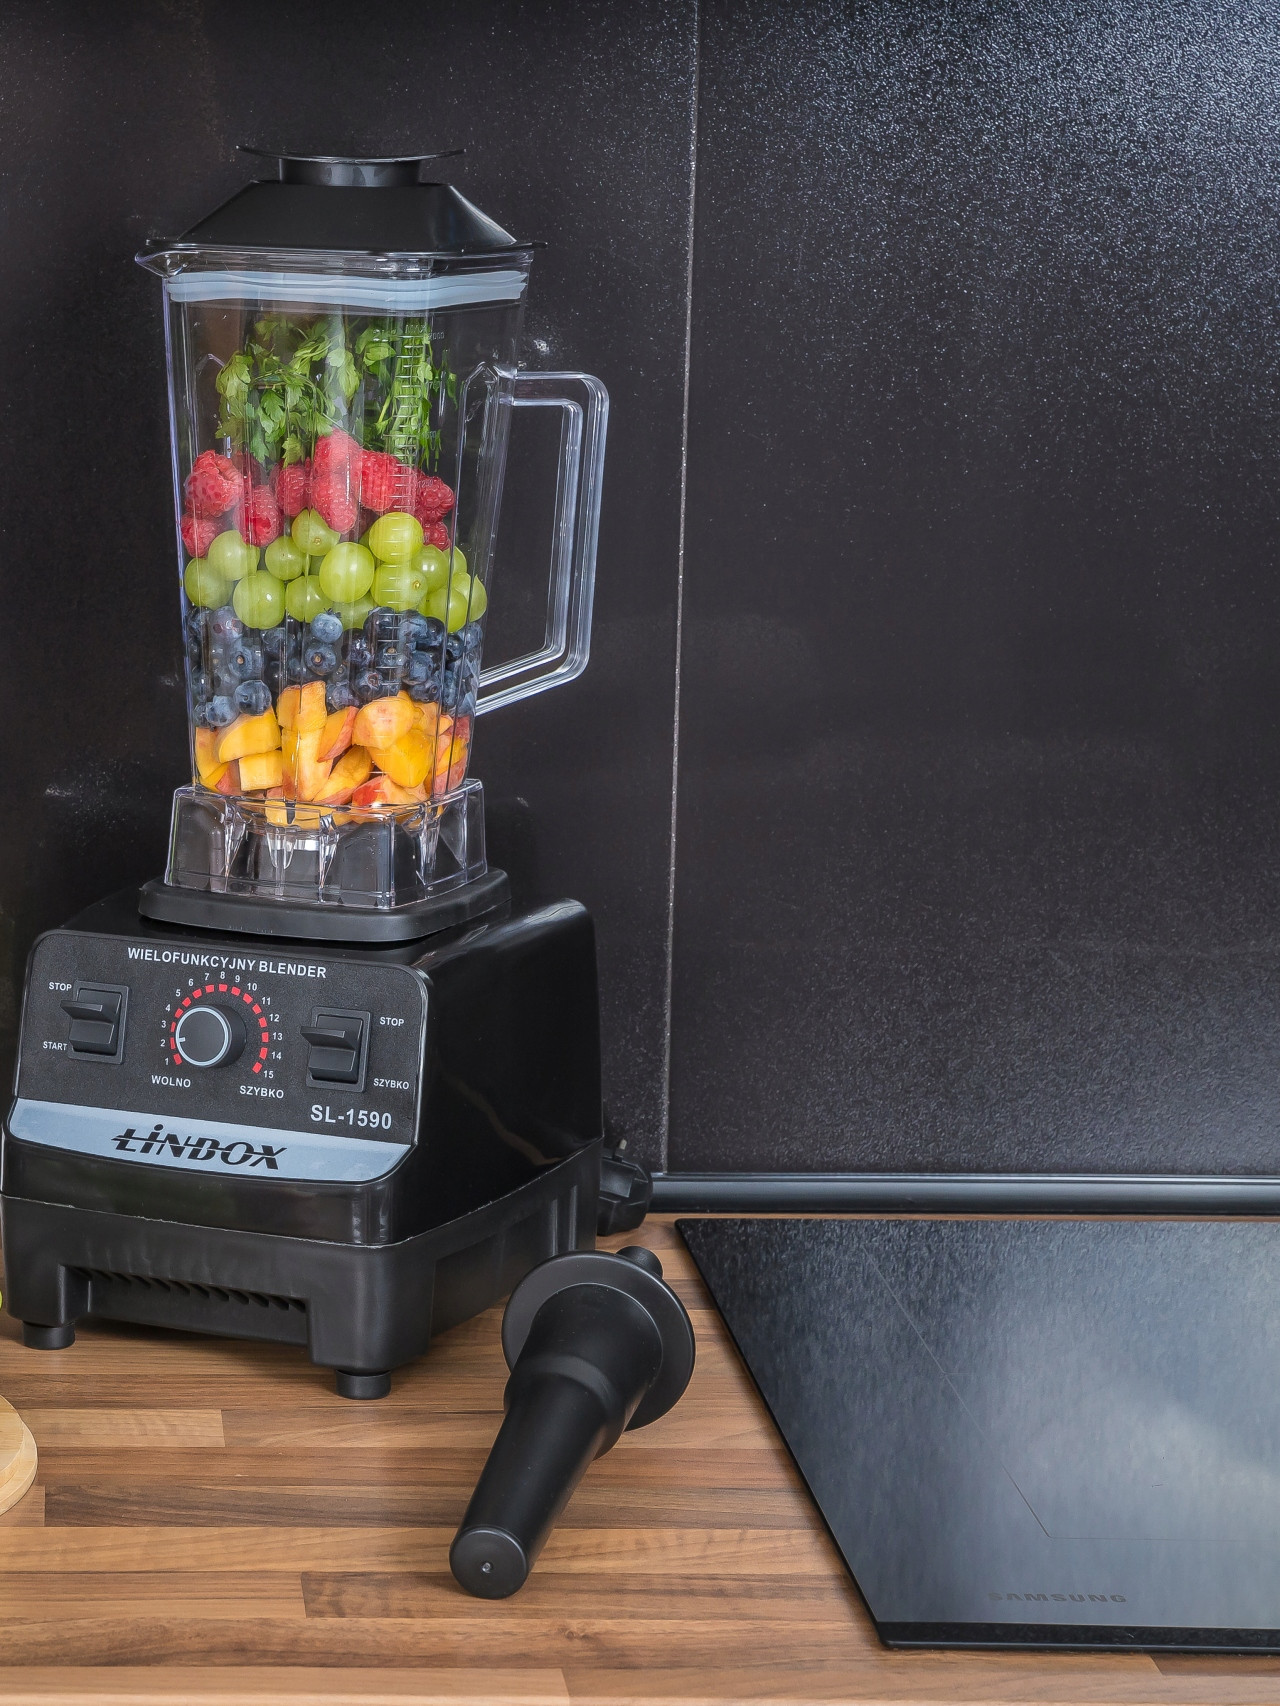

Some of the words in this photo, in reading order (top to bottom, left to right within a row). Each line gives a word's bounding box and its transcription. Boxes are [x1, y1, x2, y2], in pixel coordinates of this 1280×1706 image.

[127, 947, 257, 971] WIELOFUNKCYJNY
[258, 960, 327, 979] BLENDER
[204, 973, 210, 981] 7
[220, 971, 226, 980] 8
[234, 975, 241, 983] 9
[48, 981, 72, 992] STOP
[188, 978, 194, 987] 6
[247, 982, 258, 991] 10
[175, 989, 181, 997] 5
[261, 997, 271, 1006] 11
[165, 1004, 171, 1012] 4
[269, 1014, 280, 1022] 12
[379, 1016, 405, 1027] STOP
[161, 1020, 167, 1029] 3
[272, 1032, 283, 1041] 13
[42, 1041, 68, 1051] START
[160, 1039, 166, 1048] 2
[271, 1051, 282, 1060] 14
[164, 1058, 169, 1066] 1
[263, 1070, 274, 1079] 15
[151, 1075, 191, 1088] WOLNO
[373, 1078, 410, 1090] SZYBKO
[239, 1085, 284, 1099] SZYBKO
[310, 1104, 392, 1130] SL-1590
[987, 1592, 1127, 1603] SAMSUNG
